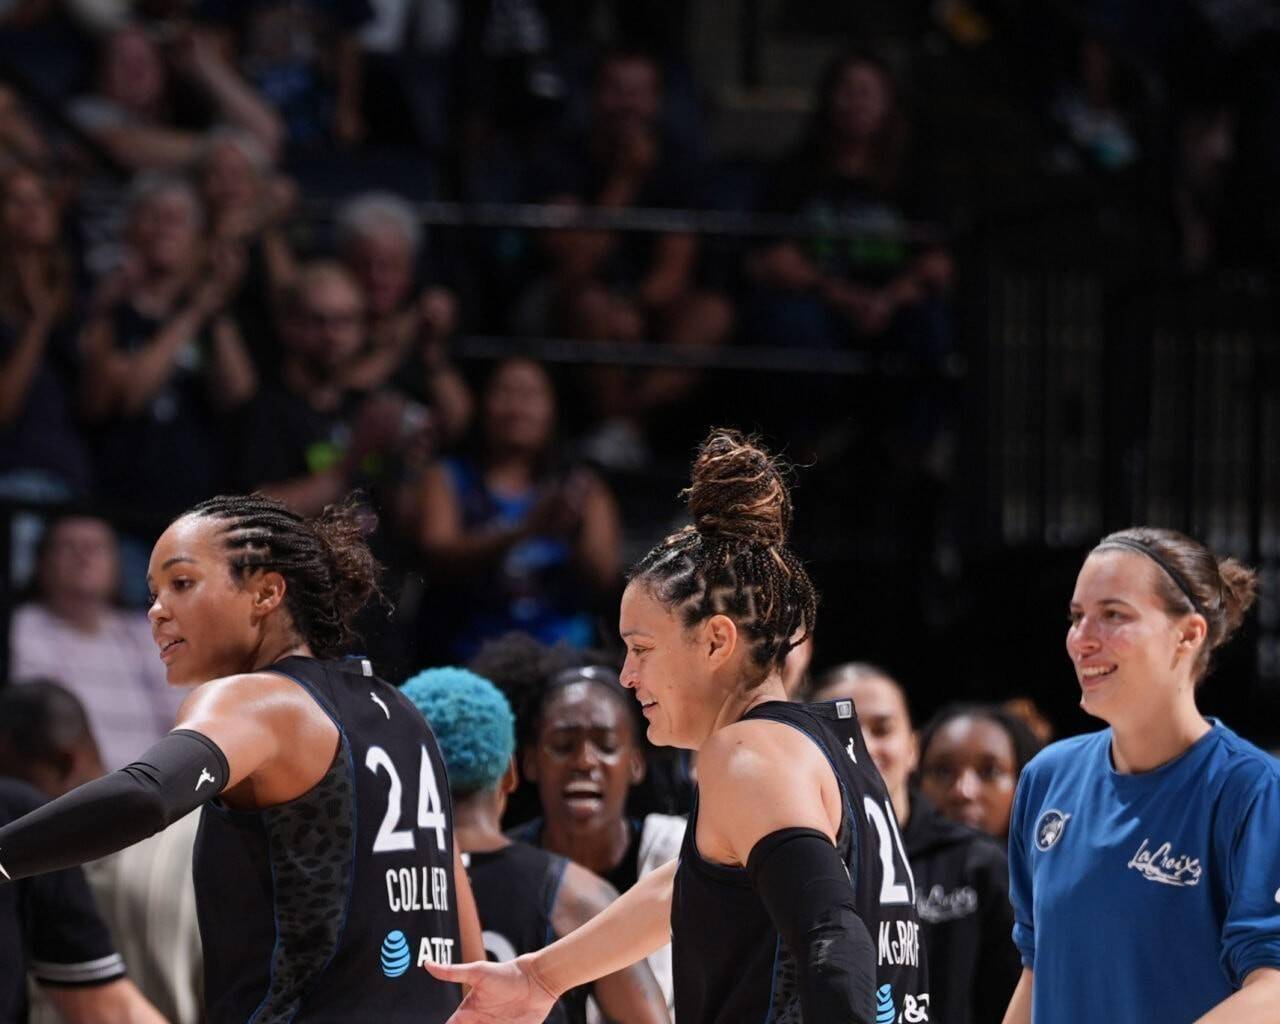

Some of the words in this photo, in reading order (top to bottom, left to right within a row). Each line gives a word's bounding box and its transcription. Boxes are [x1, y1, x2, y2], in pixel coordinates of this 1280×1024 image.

[365, 744, 447, 853] 24
[385, 866, 449, 913] COLLIER
[416, 936, 455, 968] AT&T
